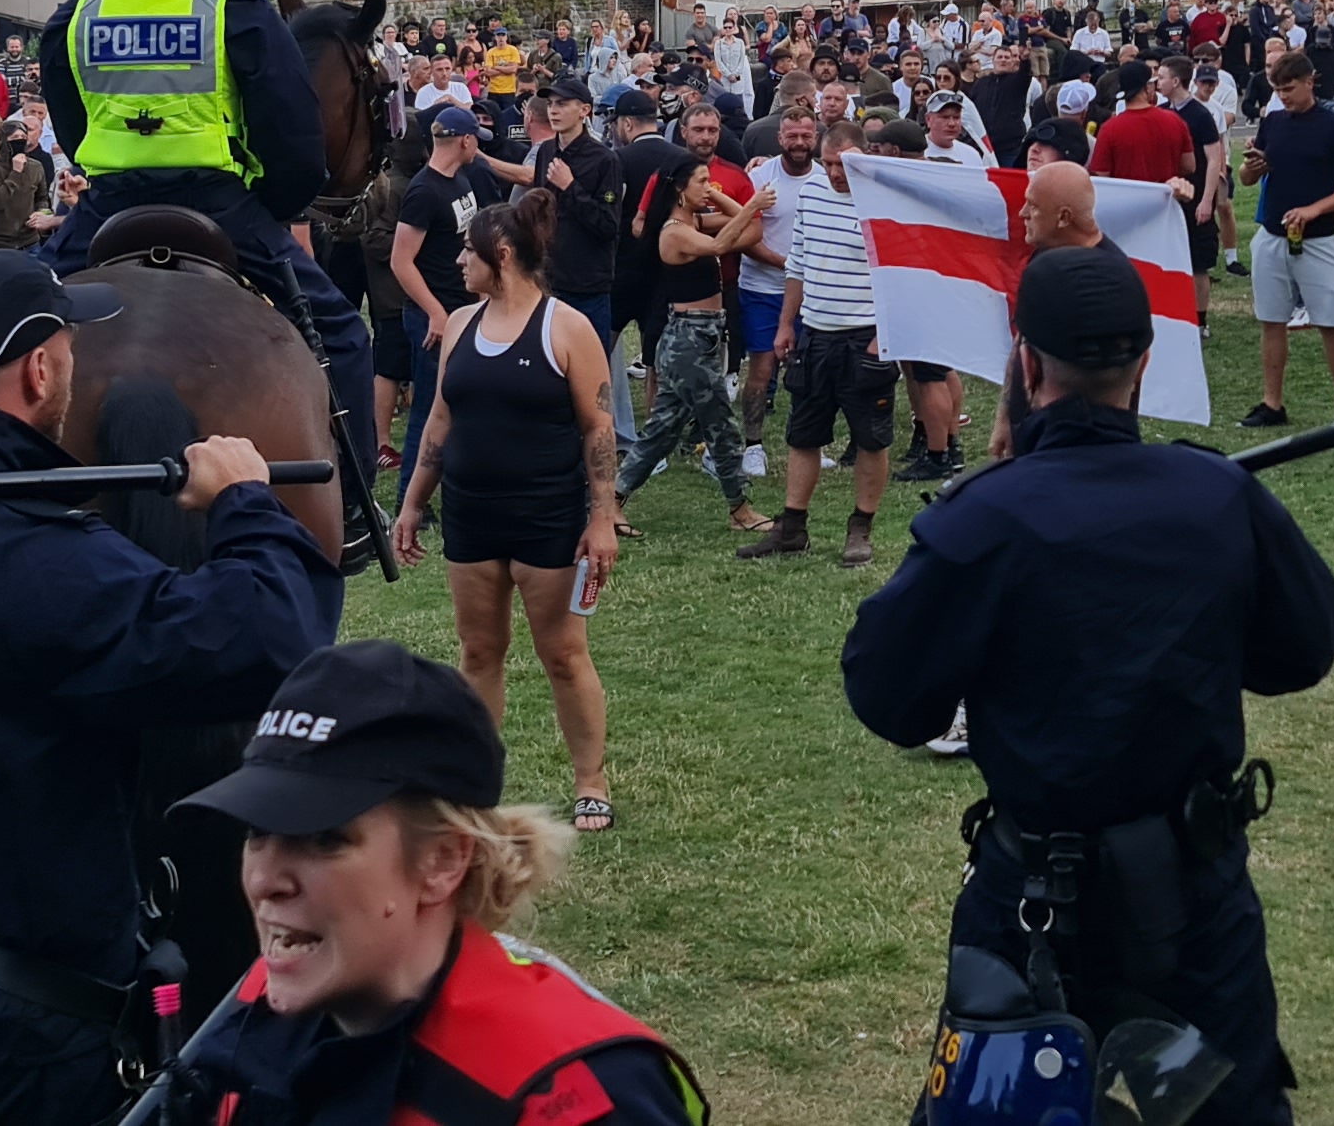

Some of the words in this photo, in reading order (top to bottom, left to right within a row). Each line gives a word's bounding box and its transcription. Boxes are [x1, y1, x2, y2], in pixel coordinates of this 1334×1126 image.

[92, 23, 197, 56] POLICE
[256, 709, 337, 742] OLICE
[575, 799, 610, 813] EA7
